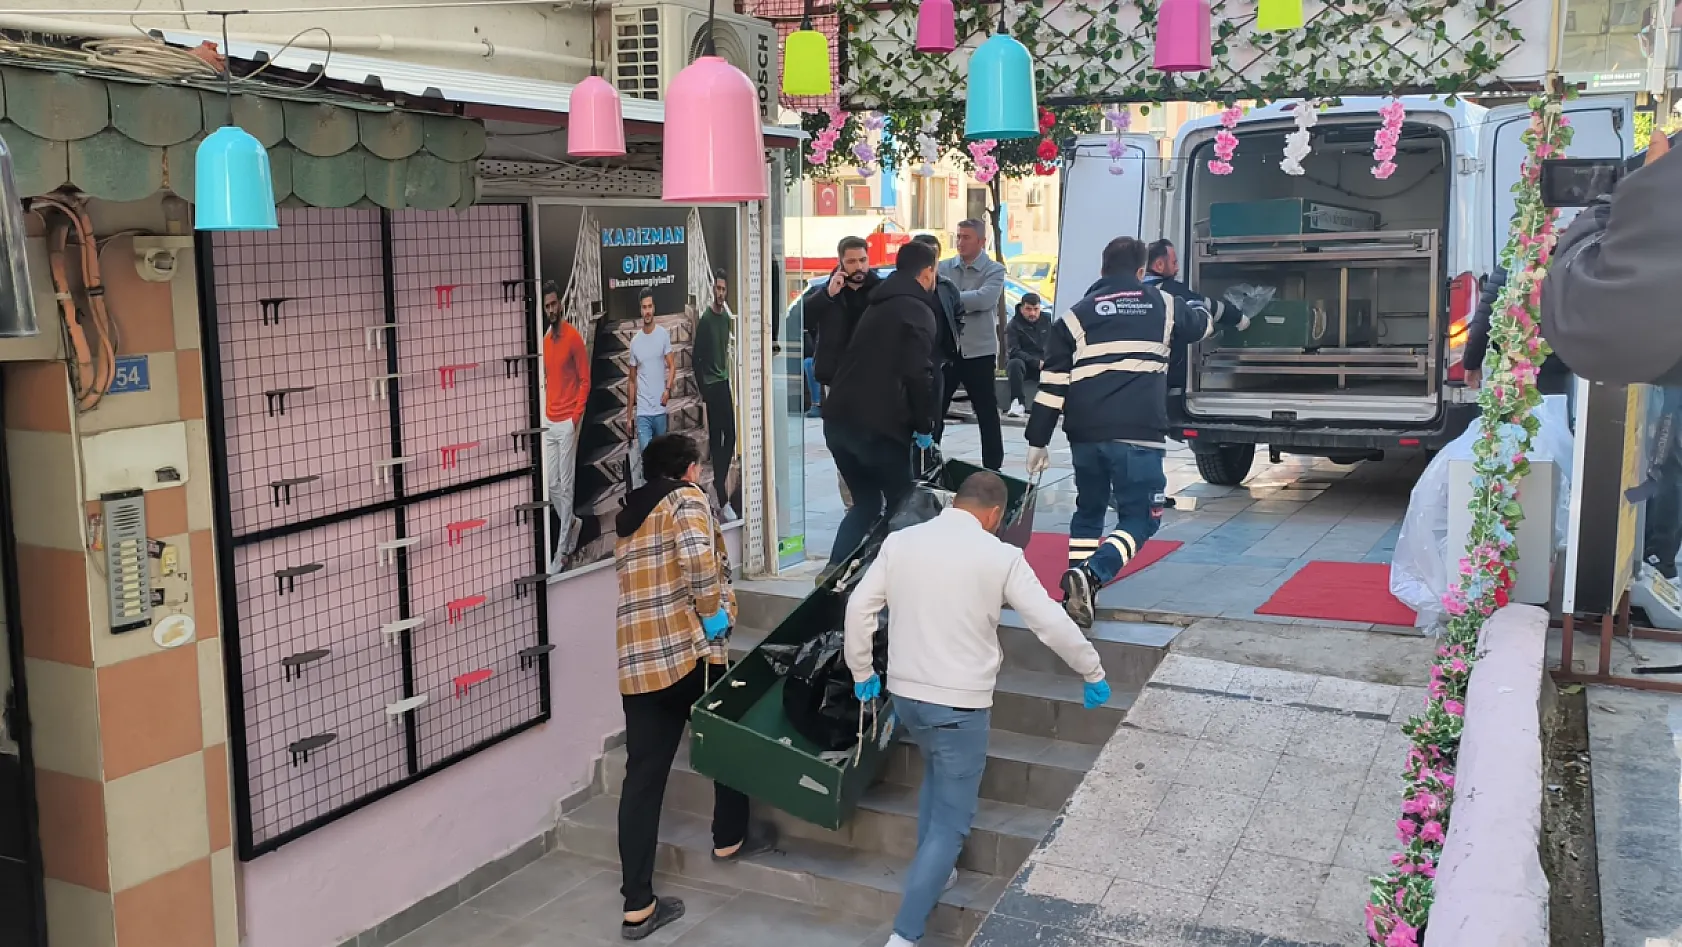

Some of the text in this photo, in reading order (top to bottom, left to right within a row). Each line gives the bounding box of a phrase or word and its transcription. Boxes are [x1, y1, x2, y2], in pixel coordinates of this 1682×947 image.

[757, 33, 769, 117] BOSCH
[601, 226, 685, 247] KARİZMAN
[622, 253, 668, 274] GİYİM
[116, 365, 141, 386] 54
